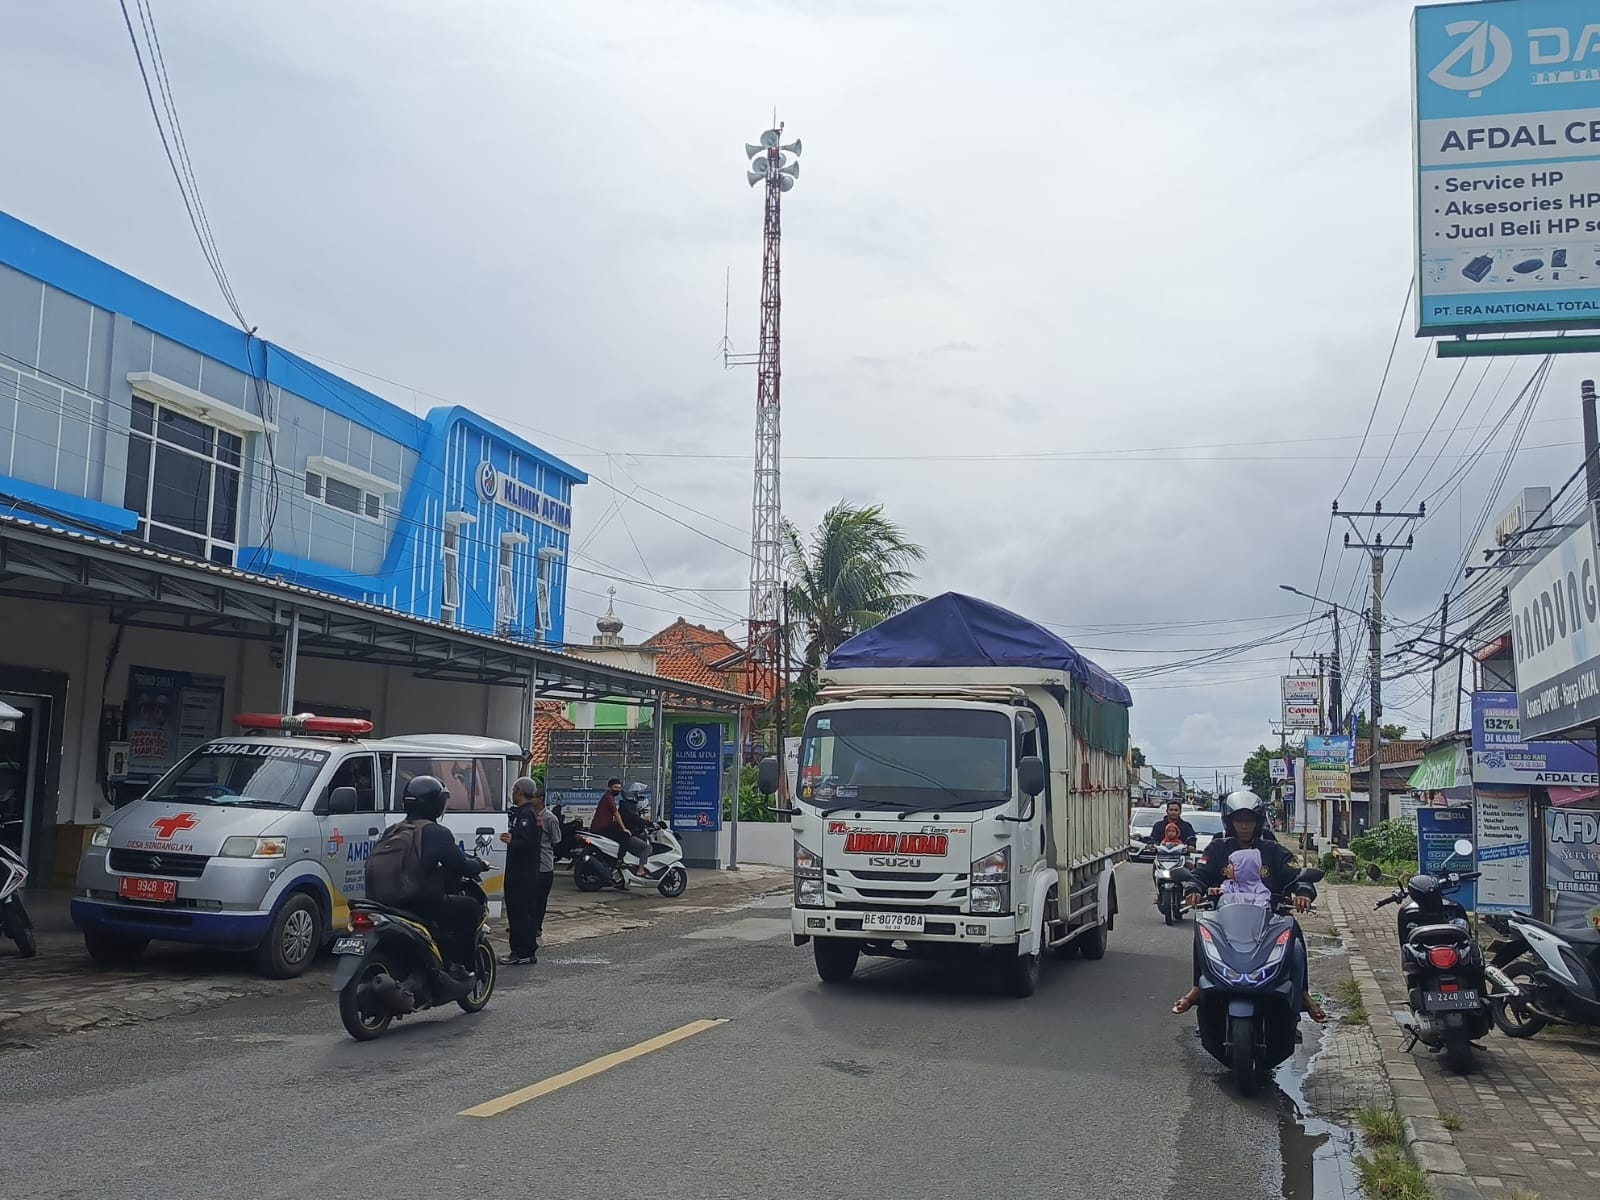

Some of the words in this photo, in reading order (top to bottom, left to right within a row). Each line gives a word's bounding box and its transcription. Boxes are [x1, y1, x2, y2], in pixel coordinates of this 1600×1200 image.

[1573, 69, 1600, 81] DA
[1440, 125, 1556, 152] AFDAL
[1445, 175, 1525, 192] Service
[1532, 172, 1563, 187] HP
[1444, 196, 1563, 216] Aksesories
[1569, 193, 1600, 208] HP
[1446, 222, 1494, 239] Jual
[1501, 220, 1541, 237] Beli
[1548, 218, 1580, 234] HP
[1434, 306, 1452, 316] PT.
[1456, 305, 1482, 315] ERA
[1486, 302, 1555, 314] NATIONAL
[1557, 300, 1600, 311] TOTAL
[504, 479, 540, 514] KLINIK
[541, 497, 571, 528] AFINA
[1514, 556, 1598, 664] BANDUNG
[1562, 682, 1580, 709] Harga
[1578, 669, 1599, 699] LOKAL
[1484, 719, 1514, 730] 132%
[1484, 733, 1494, 742] DI
[676, 751, 697, 759] KLINIK
[1535, 773, 1578, 783] AFDAL
[1581, 774, 1598, 784] CE
[700, 815, 707, 823] 24
[1551, 812, 1600, 843] AFD
[127, 840, 144, 849] DESA
[144, 841, 193, 852] SINDANGLAYA
[844, 832, 898, 855] ADRIAN
[898, 832, 949, 857] AKBAR
[869, 857, 921, 867] ISUZU
[1574, 871, 1598, 881] GANTI
[122, 879, 128, 889] A
[137, 880, 157, 892] 9948
[163, 882, 174, 894] RZ
[1558, 882, 1598, 892] BERBAGAI
[865, 914, 876, 924] BE
[878, 914, 902, 925] 8078
[1427, 993, 1433, 1001] A
[1437, 993, 1458, 1001] 2240
[1464, 991, 1475, 1000] UD
